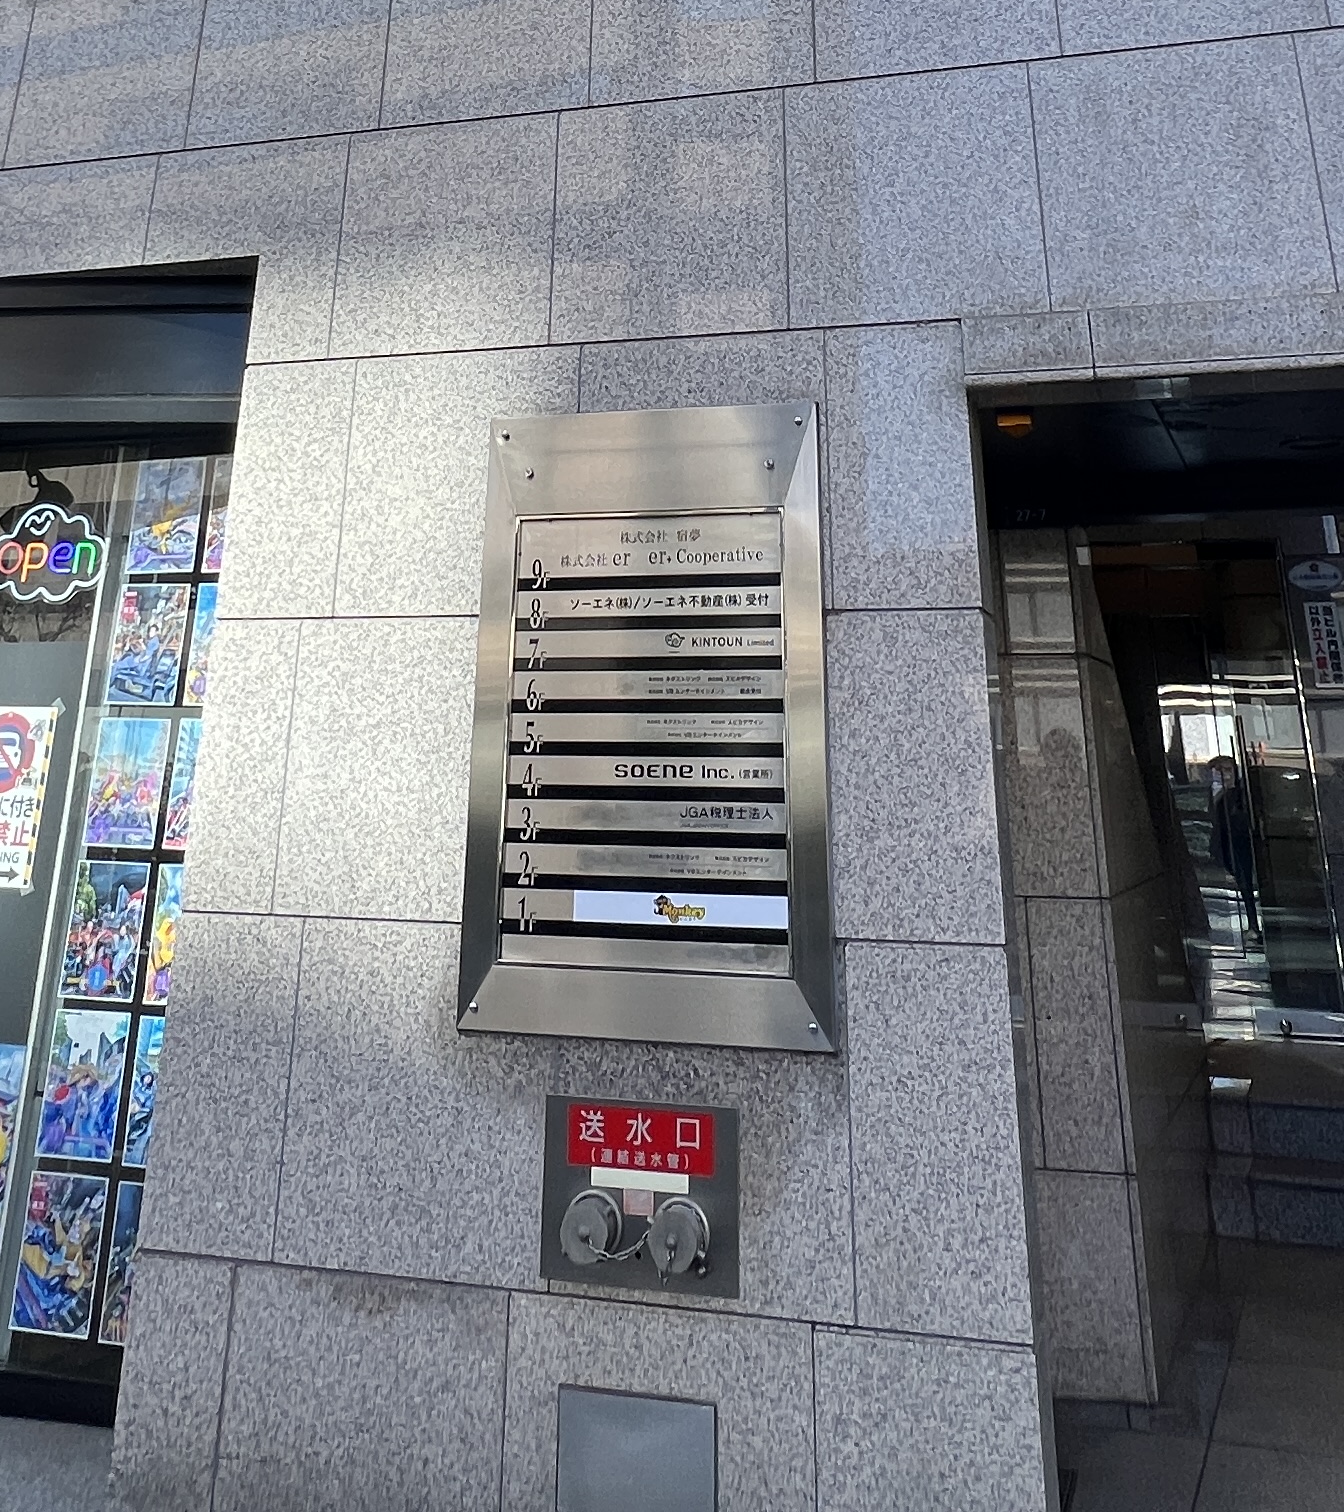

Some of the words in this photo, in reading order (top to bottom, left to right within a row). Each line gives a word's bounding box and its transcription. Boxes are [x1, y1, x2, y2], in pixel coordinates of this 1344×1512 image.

[1015, 508, 1047, 523] 27-7
[619, 529, 669, 545] 株式会社
[560, 553, 607, 568] 株式会社
[612, 551, 632, 566] er
[676, 546, 764, 565] Cooperative
[532, 559, 550, 589] 9F
[529, 598, 550, 629] 8F
[745, 593, 770, 607] 受付
[527, 638, 548, 669] 7F
[691, 637, 743, 647] KINTOUN
[526, 678, 546, 711] 6F
[523, 721, 544, 753] 5F
[521, 763, 543, 797] 4F
[701, 765, 735, 780] Inc.
[519, 806, 541, 841] 3F
[679, 806, 775, 820] JGA税理士法人
[517, 850, 539, 886] 2F
[517, 895, 537, 932] 1F
[578, 1108, 701, 1151] 送水口
